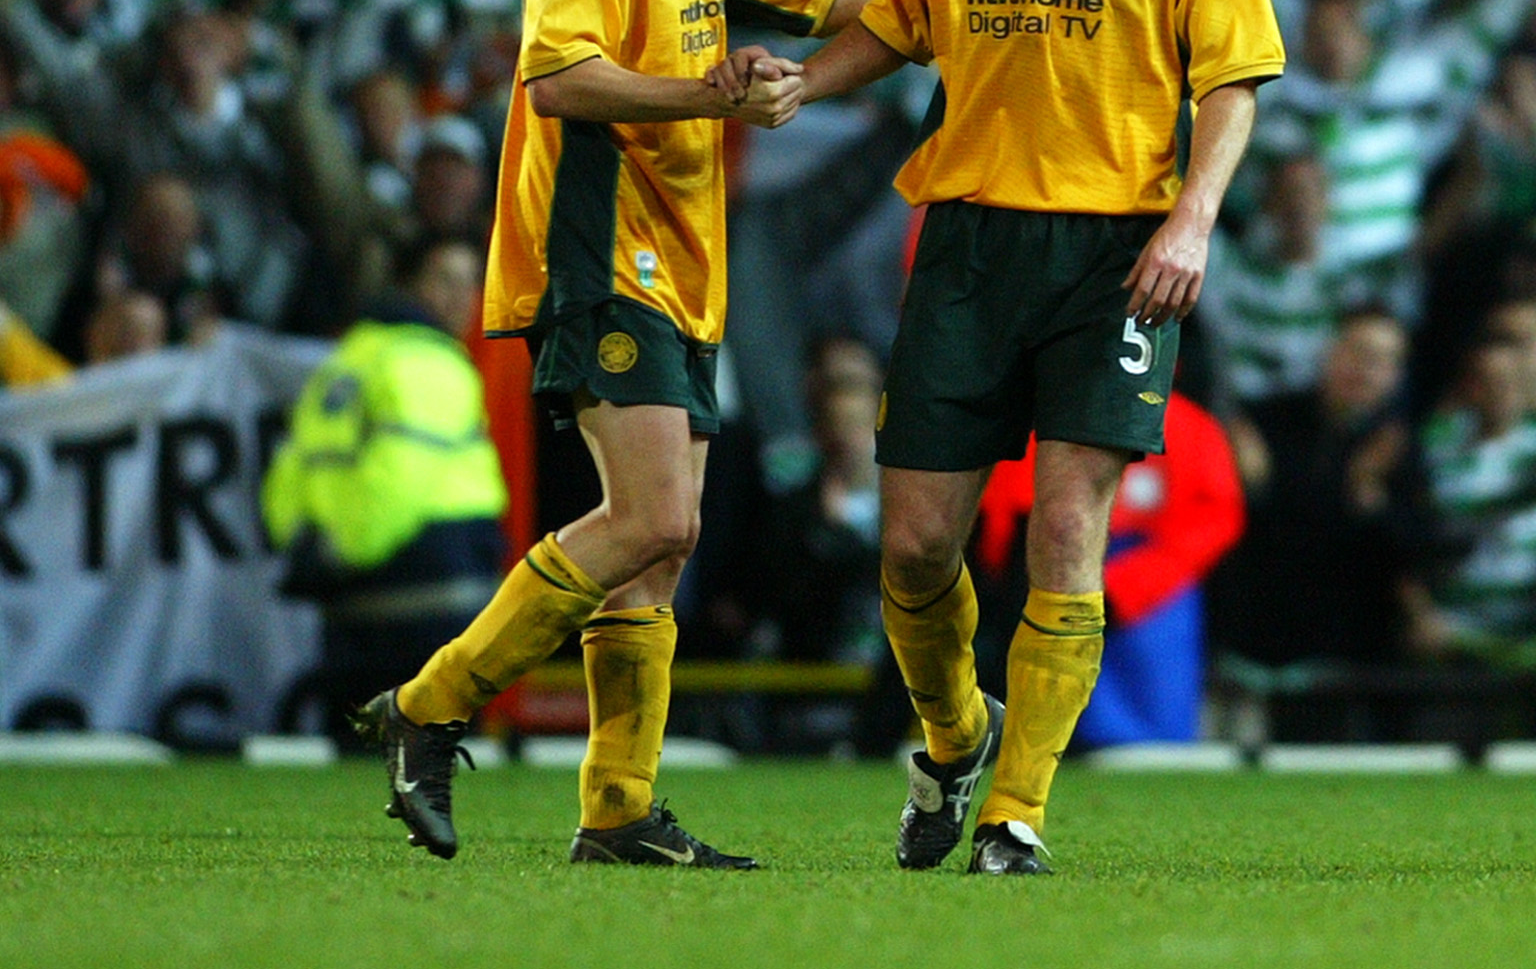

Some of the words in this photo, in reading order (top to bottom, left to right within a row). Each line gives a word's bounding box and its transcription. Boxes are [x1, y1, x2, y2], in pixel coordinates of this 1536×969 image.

[969, 11, 1050, 40] Digital
[1060, 14, 1102, 40] TV
[1118, 311, 1152, 375] 5
